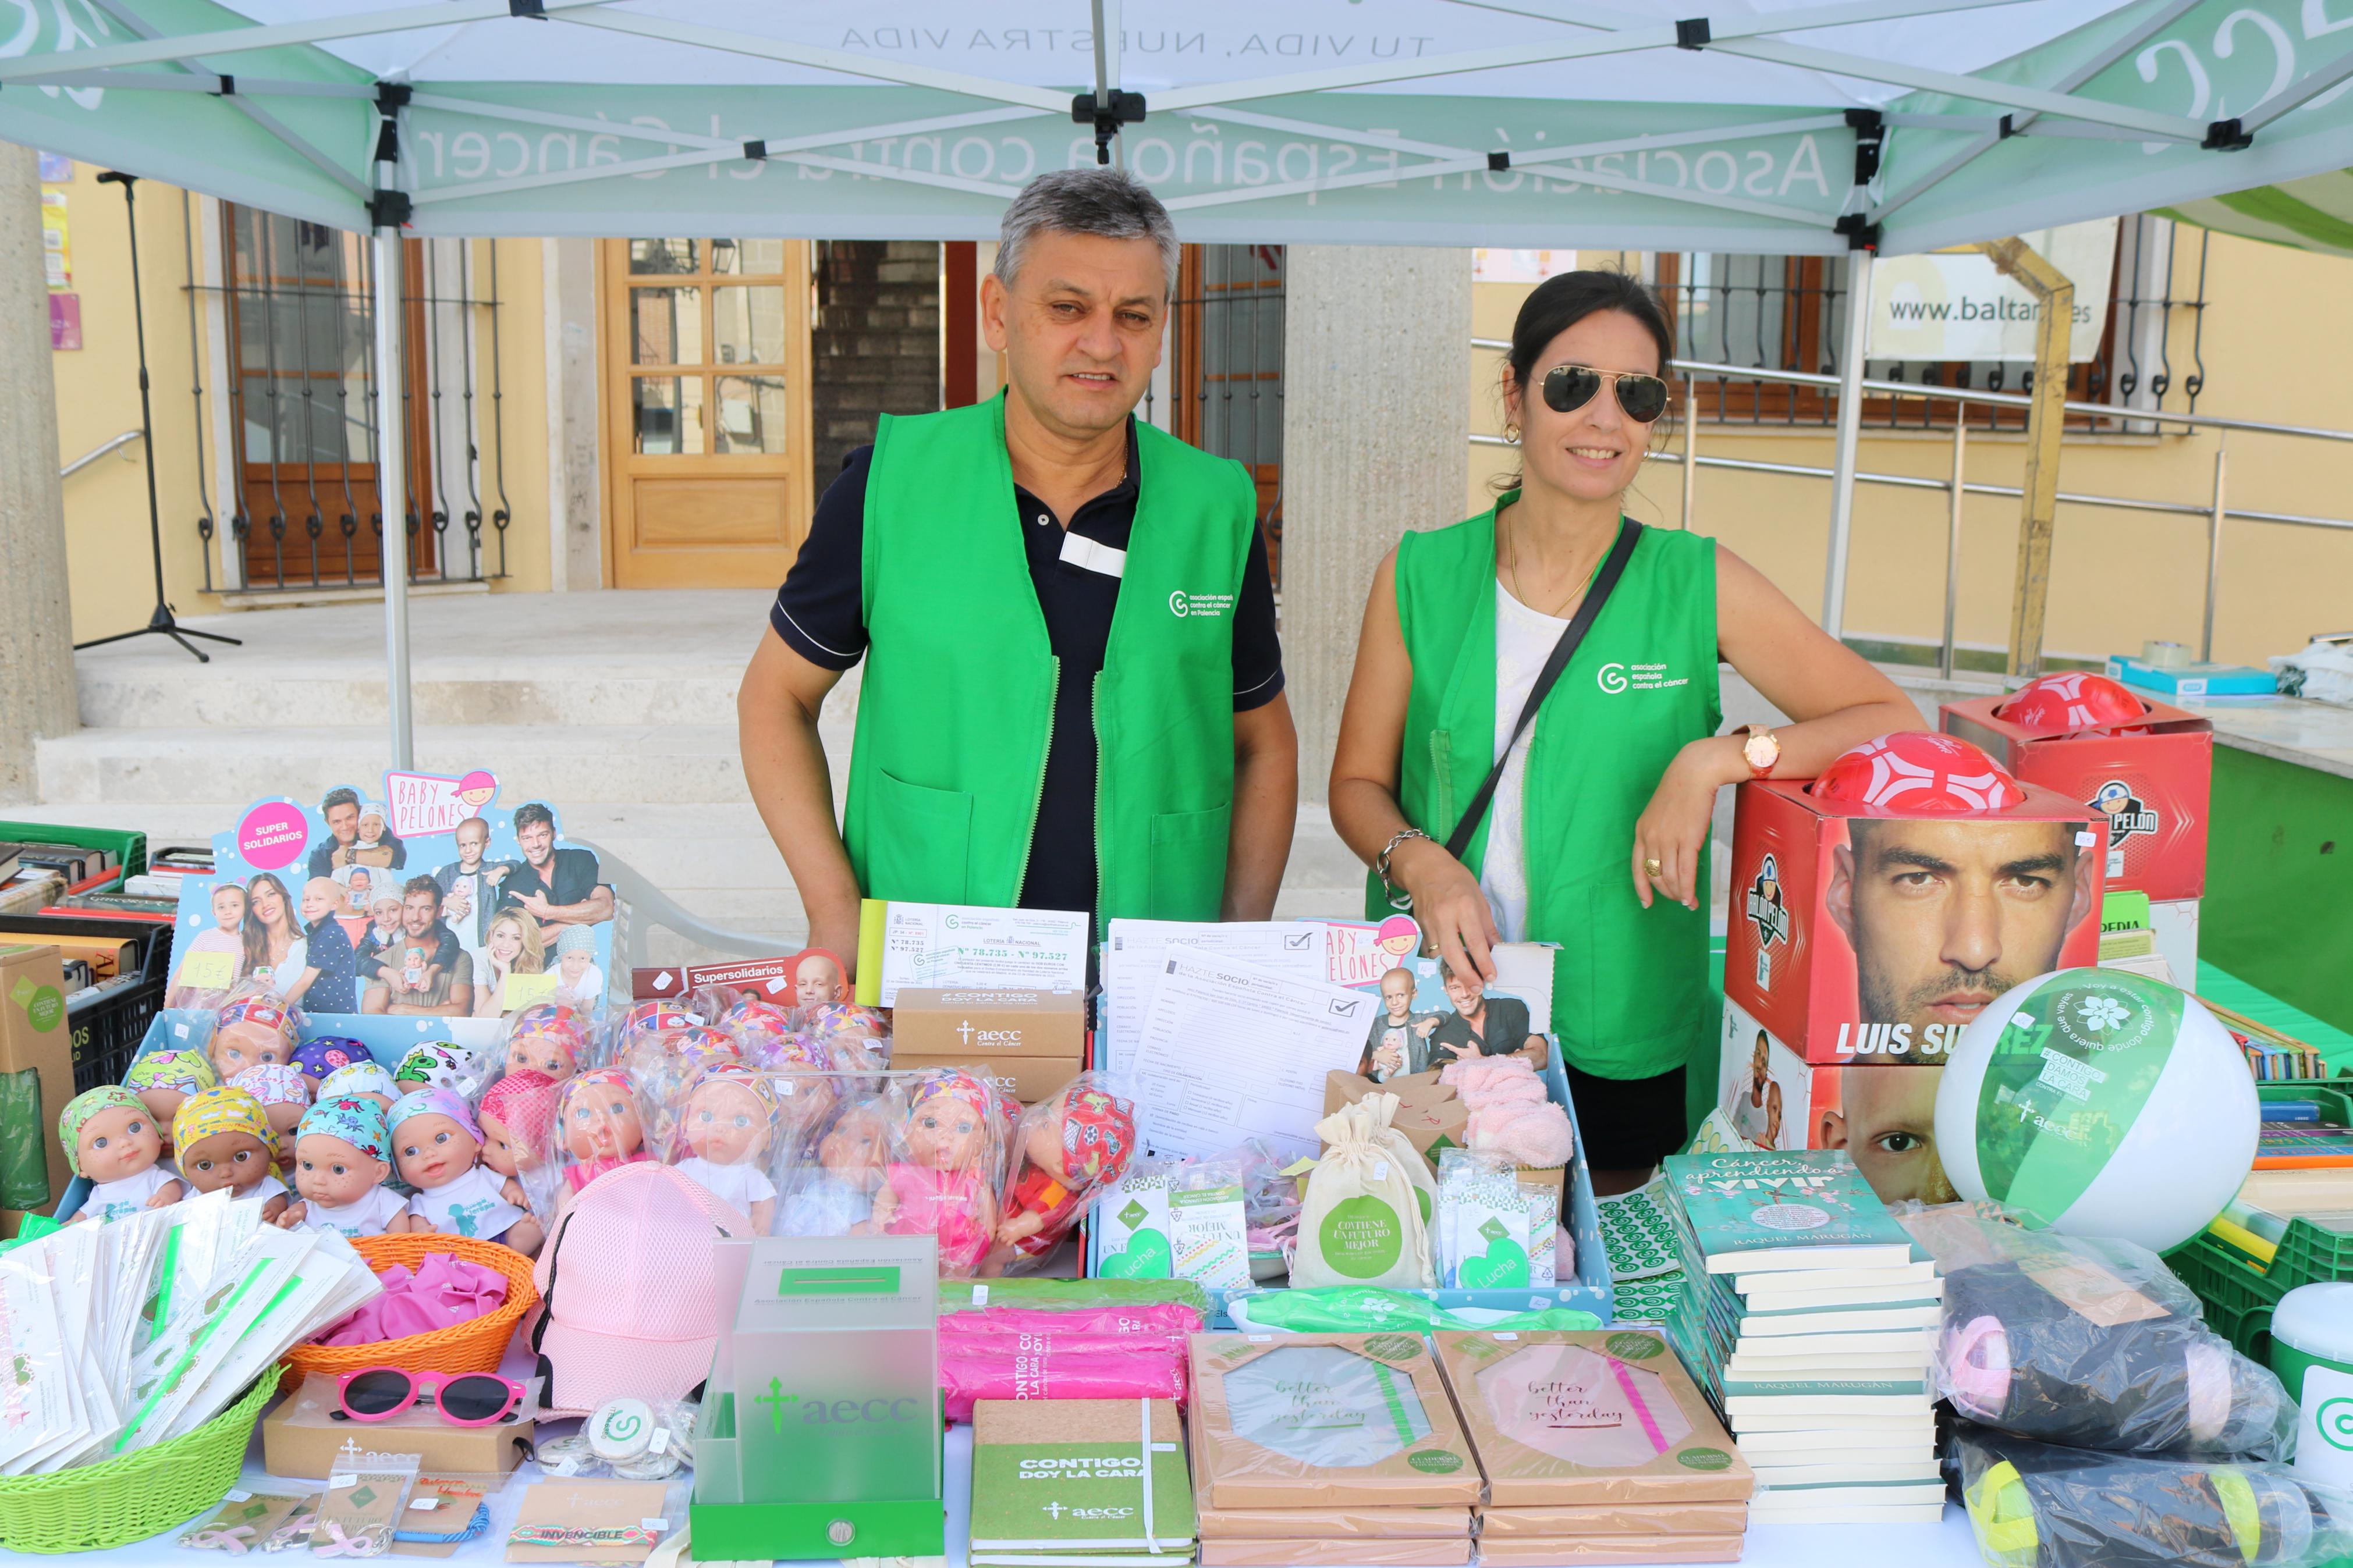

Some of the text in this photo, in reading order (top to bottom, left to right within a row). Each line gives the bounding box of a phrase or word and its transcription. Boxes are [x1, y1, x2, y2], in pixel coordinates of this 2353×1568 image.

[1631, 672, 1662, 681] española
[1663, 678, 1689, 688] cáncer
[399, 780, 439, 804] BABY
[400, 805, 466, 830] PELONES
[2113, 810, 2156, 832] PELÓN
[255, 822, 289, 837] SUPER
[243, 829, 303, 851] SOLIDARIOS
[1327, 929, 1357, 955] ABY
[973, 948, 1007, 957] 78.735
[1032, 951, 1068, 961] 97.527
[694, 963, 784, 986] Supersolidarios
[1179, 963, 1216, 979] HAZTE
[1216, 972, 1250, 986] SOCIO
[1330, 952, 1389, 982] ELONES
[2056, 991, 2074, 1015] vayas
[2119, 987, 2145, 1004] estar
[2057, 1015, 2071, 1034] que
[2140, 1004, 2155, 1036] contigo
[977, 1030, 1021, 1041] aecc
[1836, 1023, 2053, 1055] LUIS SUREZ
[2069, 1033, 2104, 1051] quiera
[2108, 1035, 2142, 1053] donde
[2046, 1062, 2086, 1085] DAMOS
[2052, 1052, 2100, 1080] CONTIGO
[2042, 1073, 2087, 1098] LA CARA
[1685, 1164, 1822, 1183] aprendiendo
[1338, 1219, 1387, 1230] CONTIENE
[1344, 1239, 1379, 1250] MEJOR
[1734, 1232, 1872, 1246] RAQUEL MARUGÁN
[1477, 1257, 1518, 1289] Lucha
[1275, 1380, 1336, 1393] better
[1528, 1381, 1588, 1394] better
[1754, 1379, 1893, 1390] RAQUEL MARUGÁN
[1546, 1395, 1595, 1407] than
[802, 1396, 918, 1425] aecc
[1270, 1407, 1368, 1424] yesterday
[1528, 1407, 1624, 1423] yesterday
[1019, 1469, 1144, 1480] DOY LA CARA
[1072, 1507, 1134, 1517] aecc
[540, 1530, 624, 1540] INVENCIBLE
